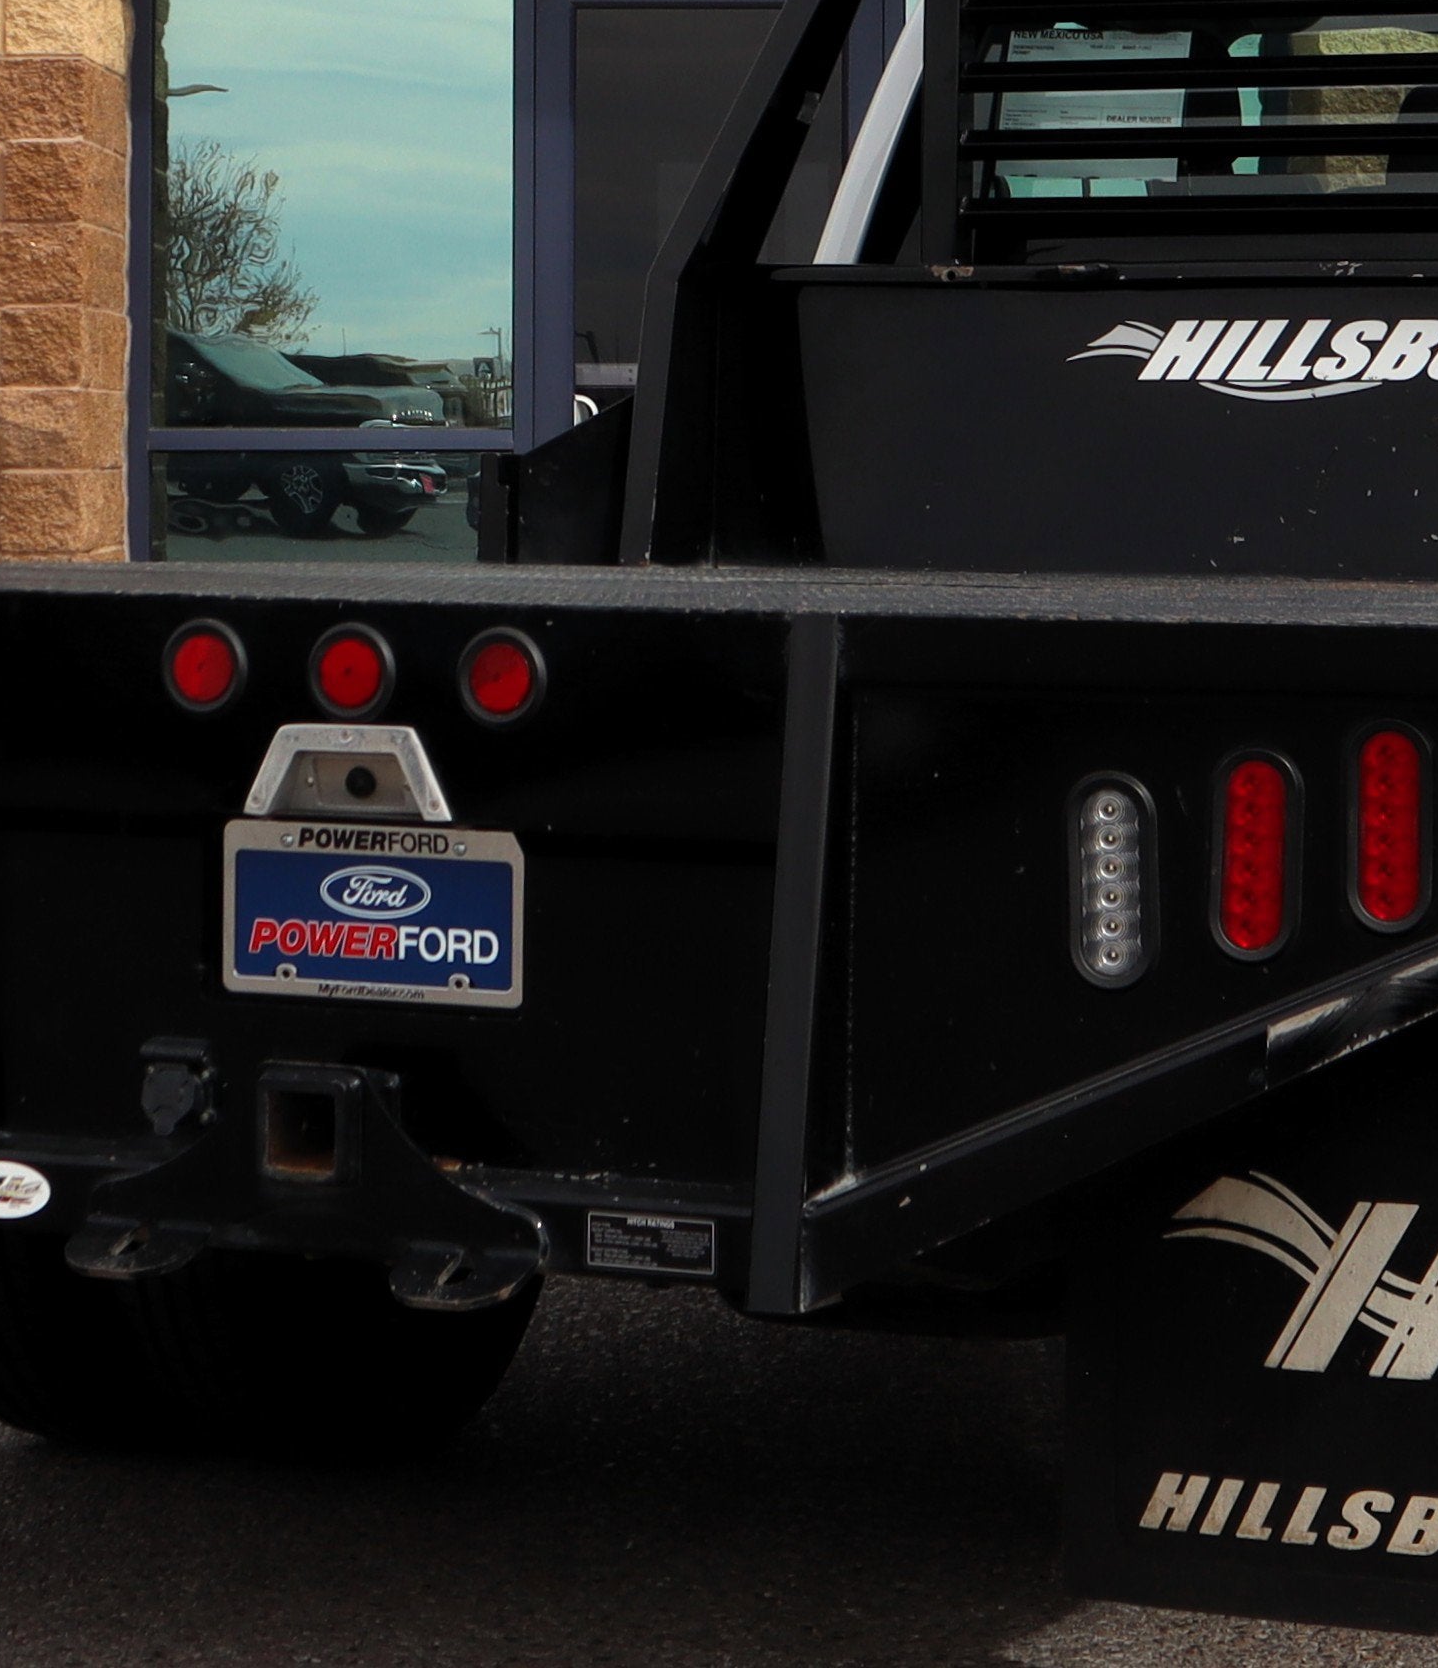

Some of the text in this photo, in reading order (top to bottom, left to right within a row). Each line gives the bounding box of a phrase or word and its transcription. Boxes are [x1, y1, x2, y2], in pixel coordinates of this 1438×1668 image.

[1013, 31, 1039, 40] NEW
[1040, 31, 1081, 41] MEXICO
[1083, 31, 1104, 41] USA
[1106, 115, 1138, 124] DEALER
[1138, 115, 1173, 124] NUMBER
[299, 829, 449, 854] POWERFORD
[342, 875, 407, 909] Ford
[250, 919, 499, 964] POWERFORD
